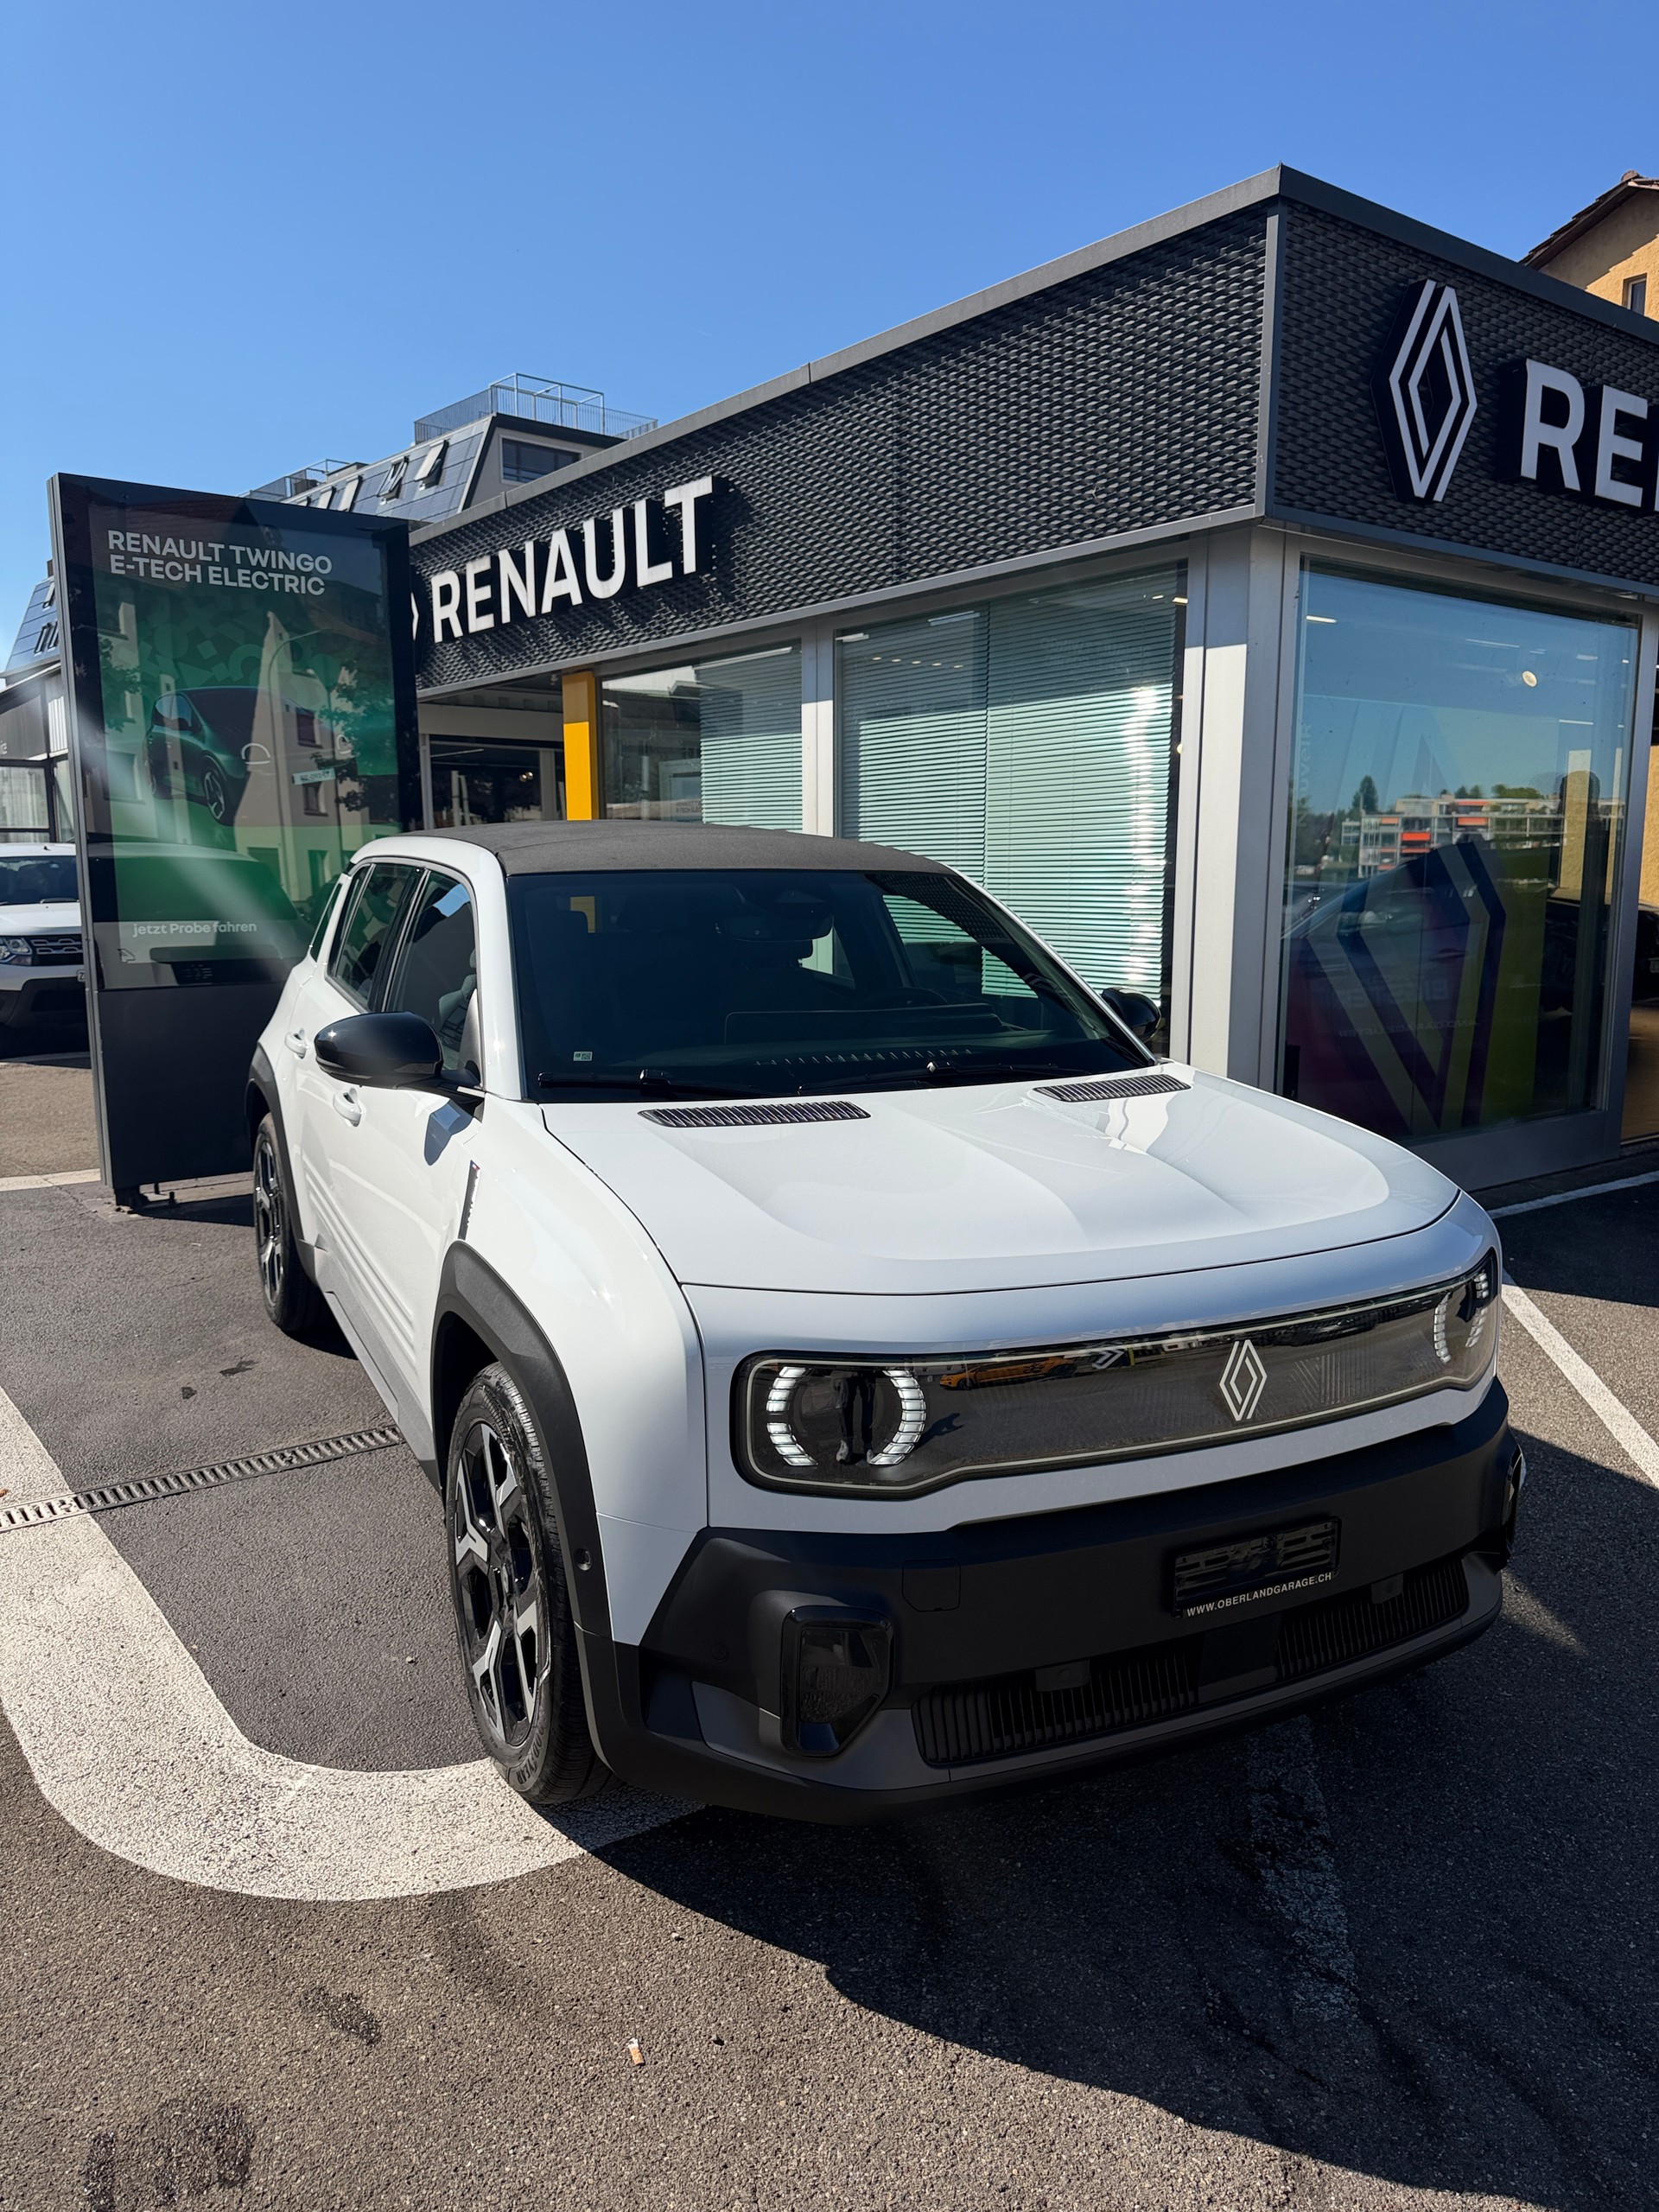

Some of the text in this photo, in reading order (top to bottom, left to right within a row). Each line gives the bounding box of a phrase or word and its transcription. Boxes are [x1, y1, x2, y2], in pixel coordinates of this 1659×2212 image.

[1521, 358, 1659, 512] RE
[108, 530, 333, 575] RENAULT TWINGO
[110, 554, 325, 596] E-TECH ELECTRIC
[431, 475, 713, 643] RENAULT
[132, 921, 257, 938] jetzt Probe fahren
[1186, 1572, 1332, 1618] WWW.OBERLANDGARAGE.CH
[516, 1719, 545, 1785] OODYEAR
